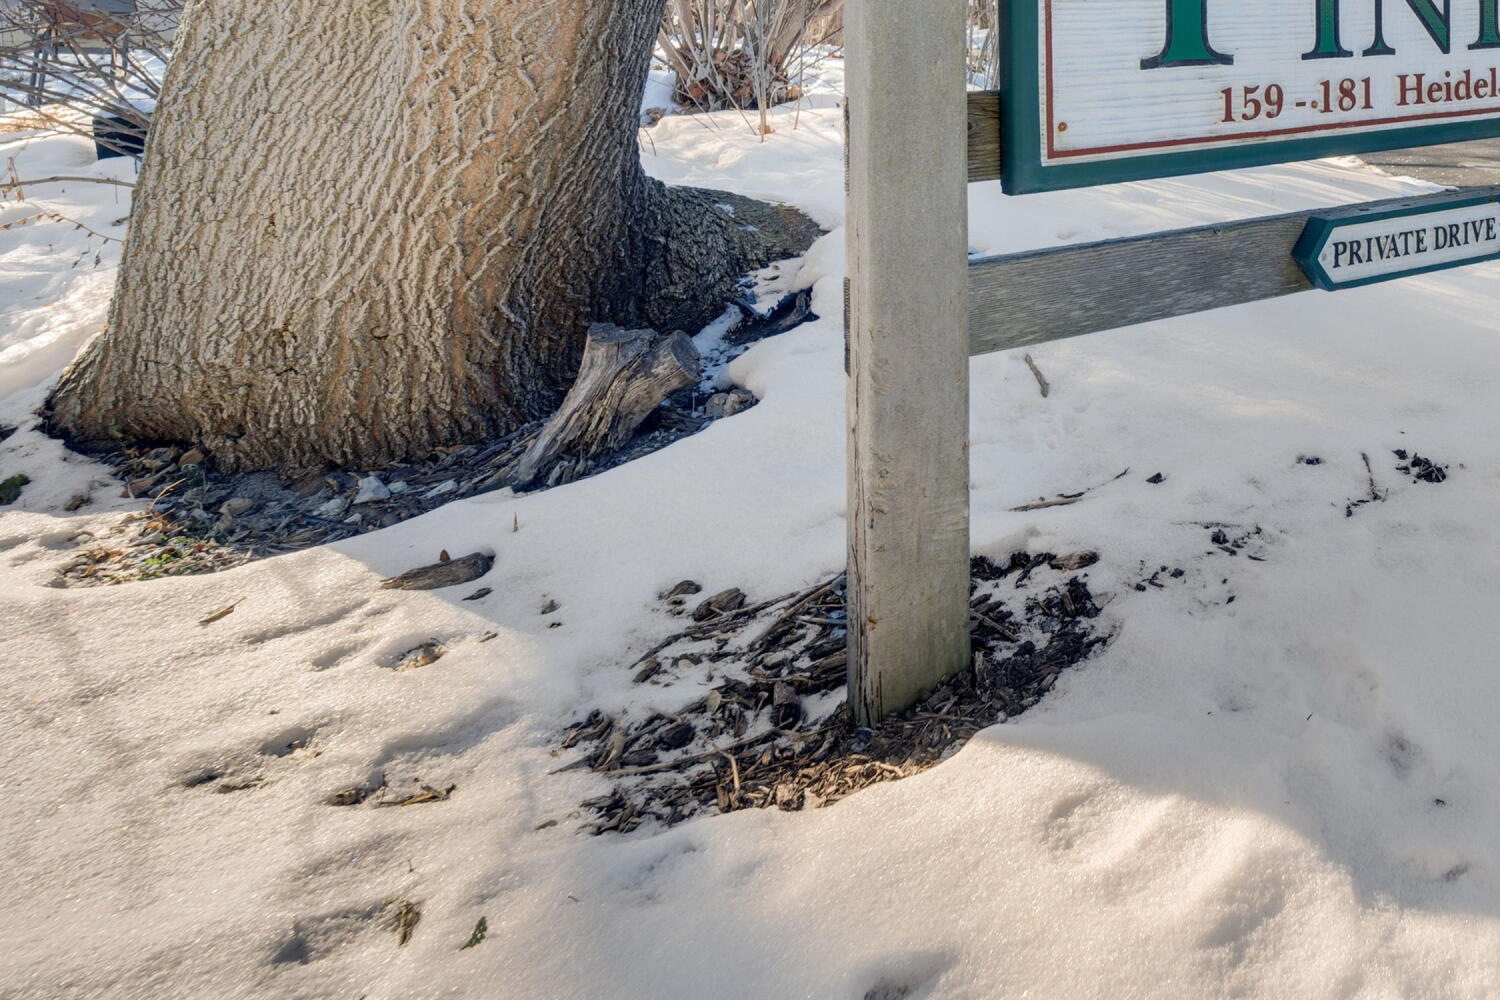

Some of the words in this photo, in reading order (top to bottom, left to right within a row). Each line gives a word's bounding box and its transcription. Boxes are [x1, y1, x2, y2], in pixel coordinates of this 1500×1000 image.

[1397, 67, 1498, 106] Heidel
[1332, 228, 1428, 268] PRIVATE
[1433, 217, 1497, 251] DRIVE
